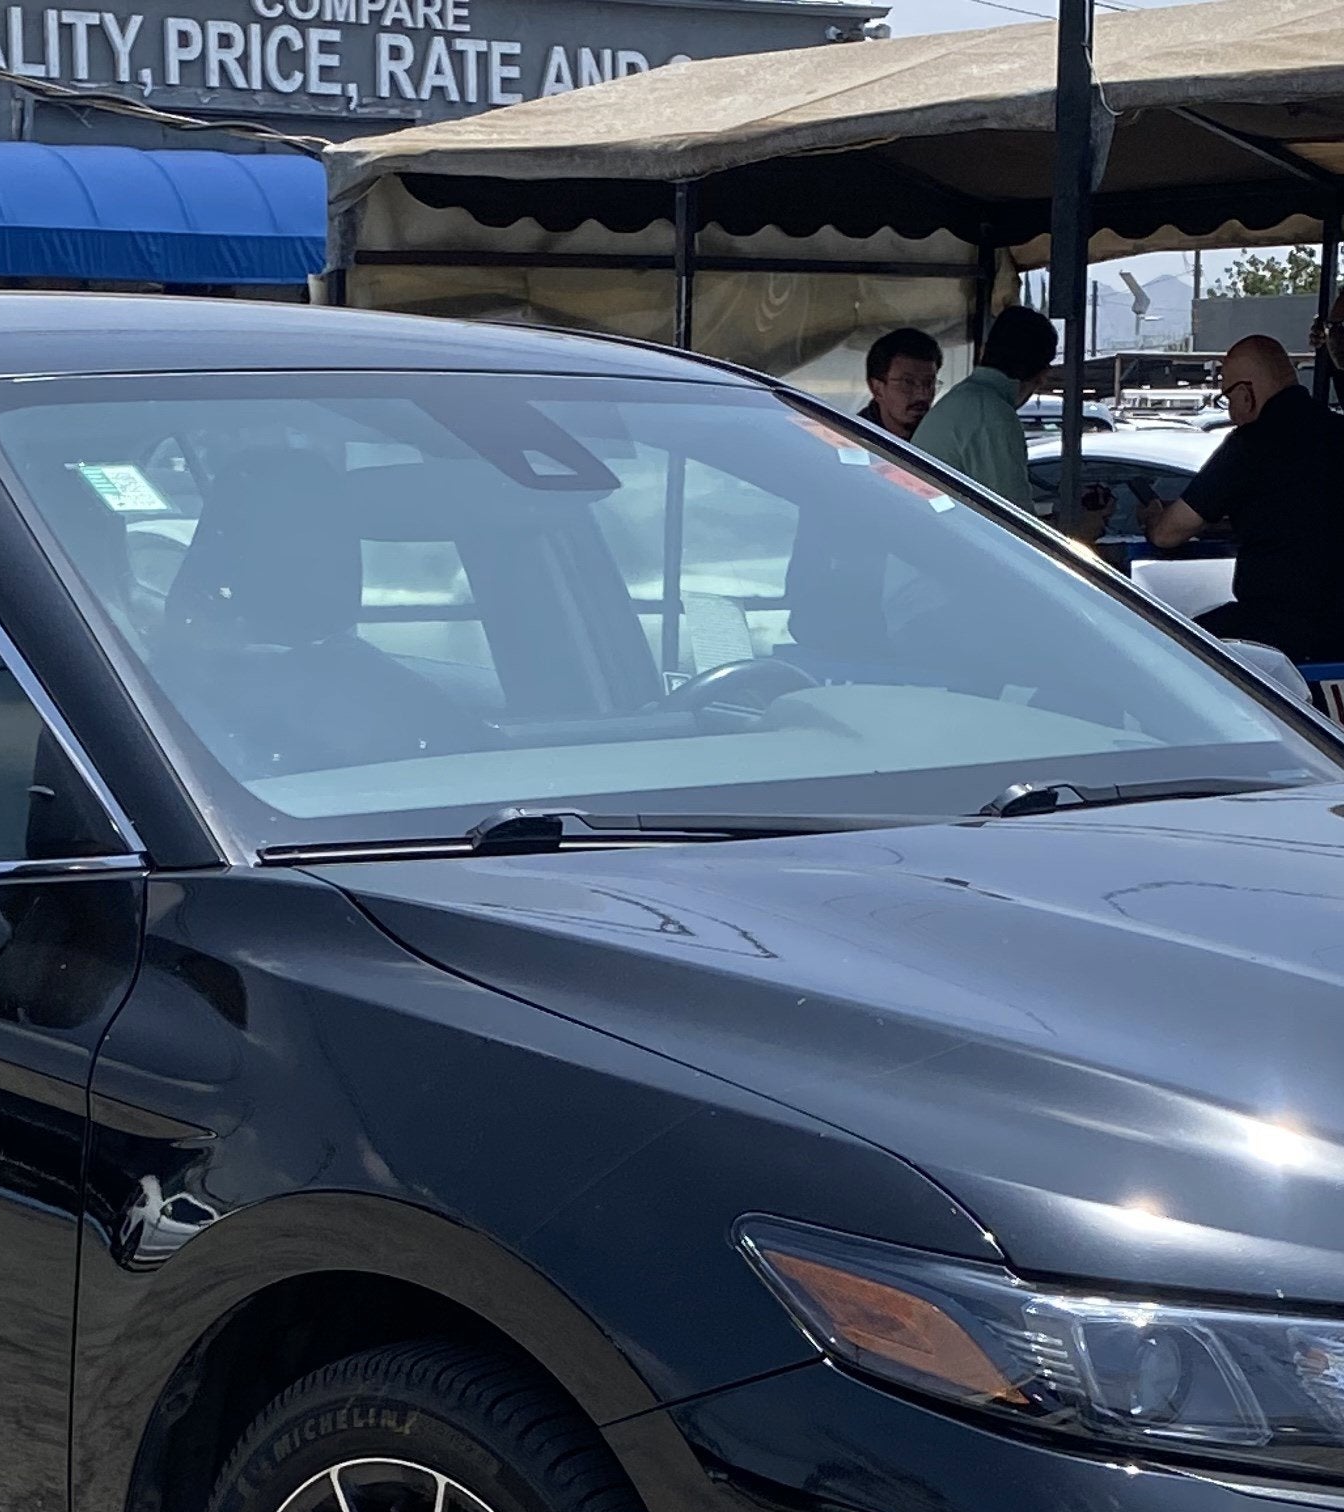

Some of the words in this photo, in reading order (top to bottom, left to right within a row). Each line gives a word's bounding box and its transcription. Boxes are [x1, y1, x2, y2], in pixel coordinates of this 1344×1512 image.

[163, 16, 358, 110] PRICE,
[374, 32, 524, 106] RATE
[272, 1407, 398, 1462] MICHELIN
